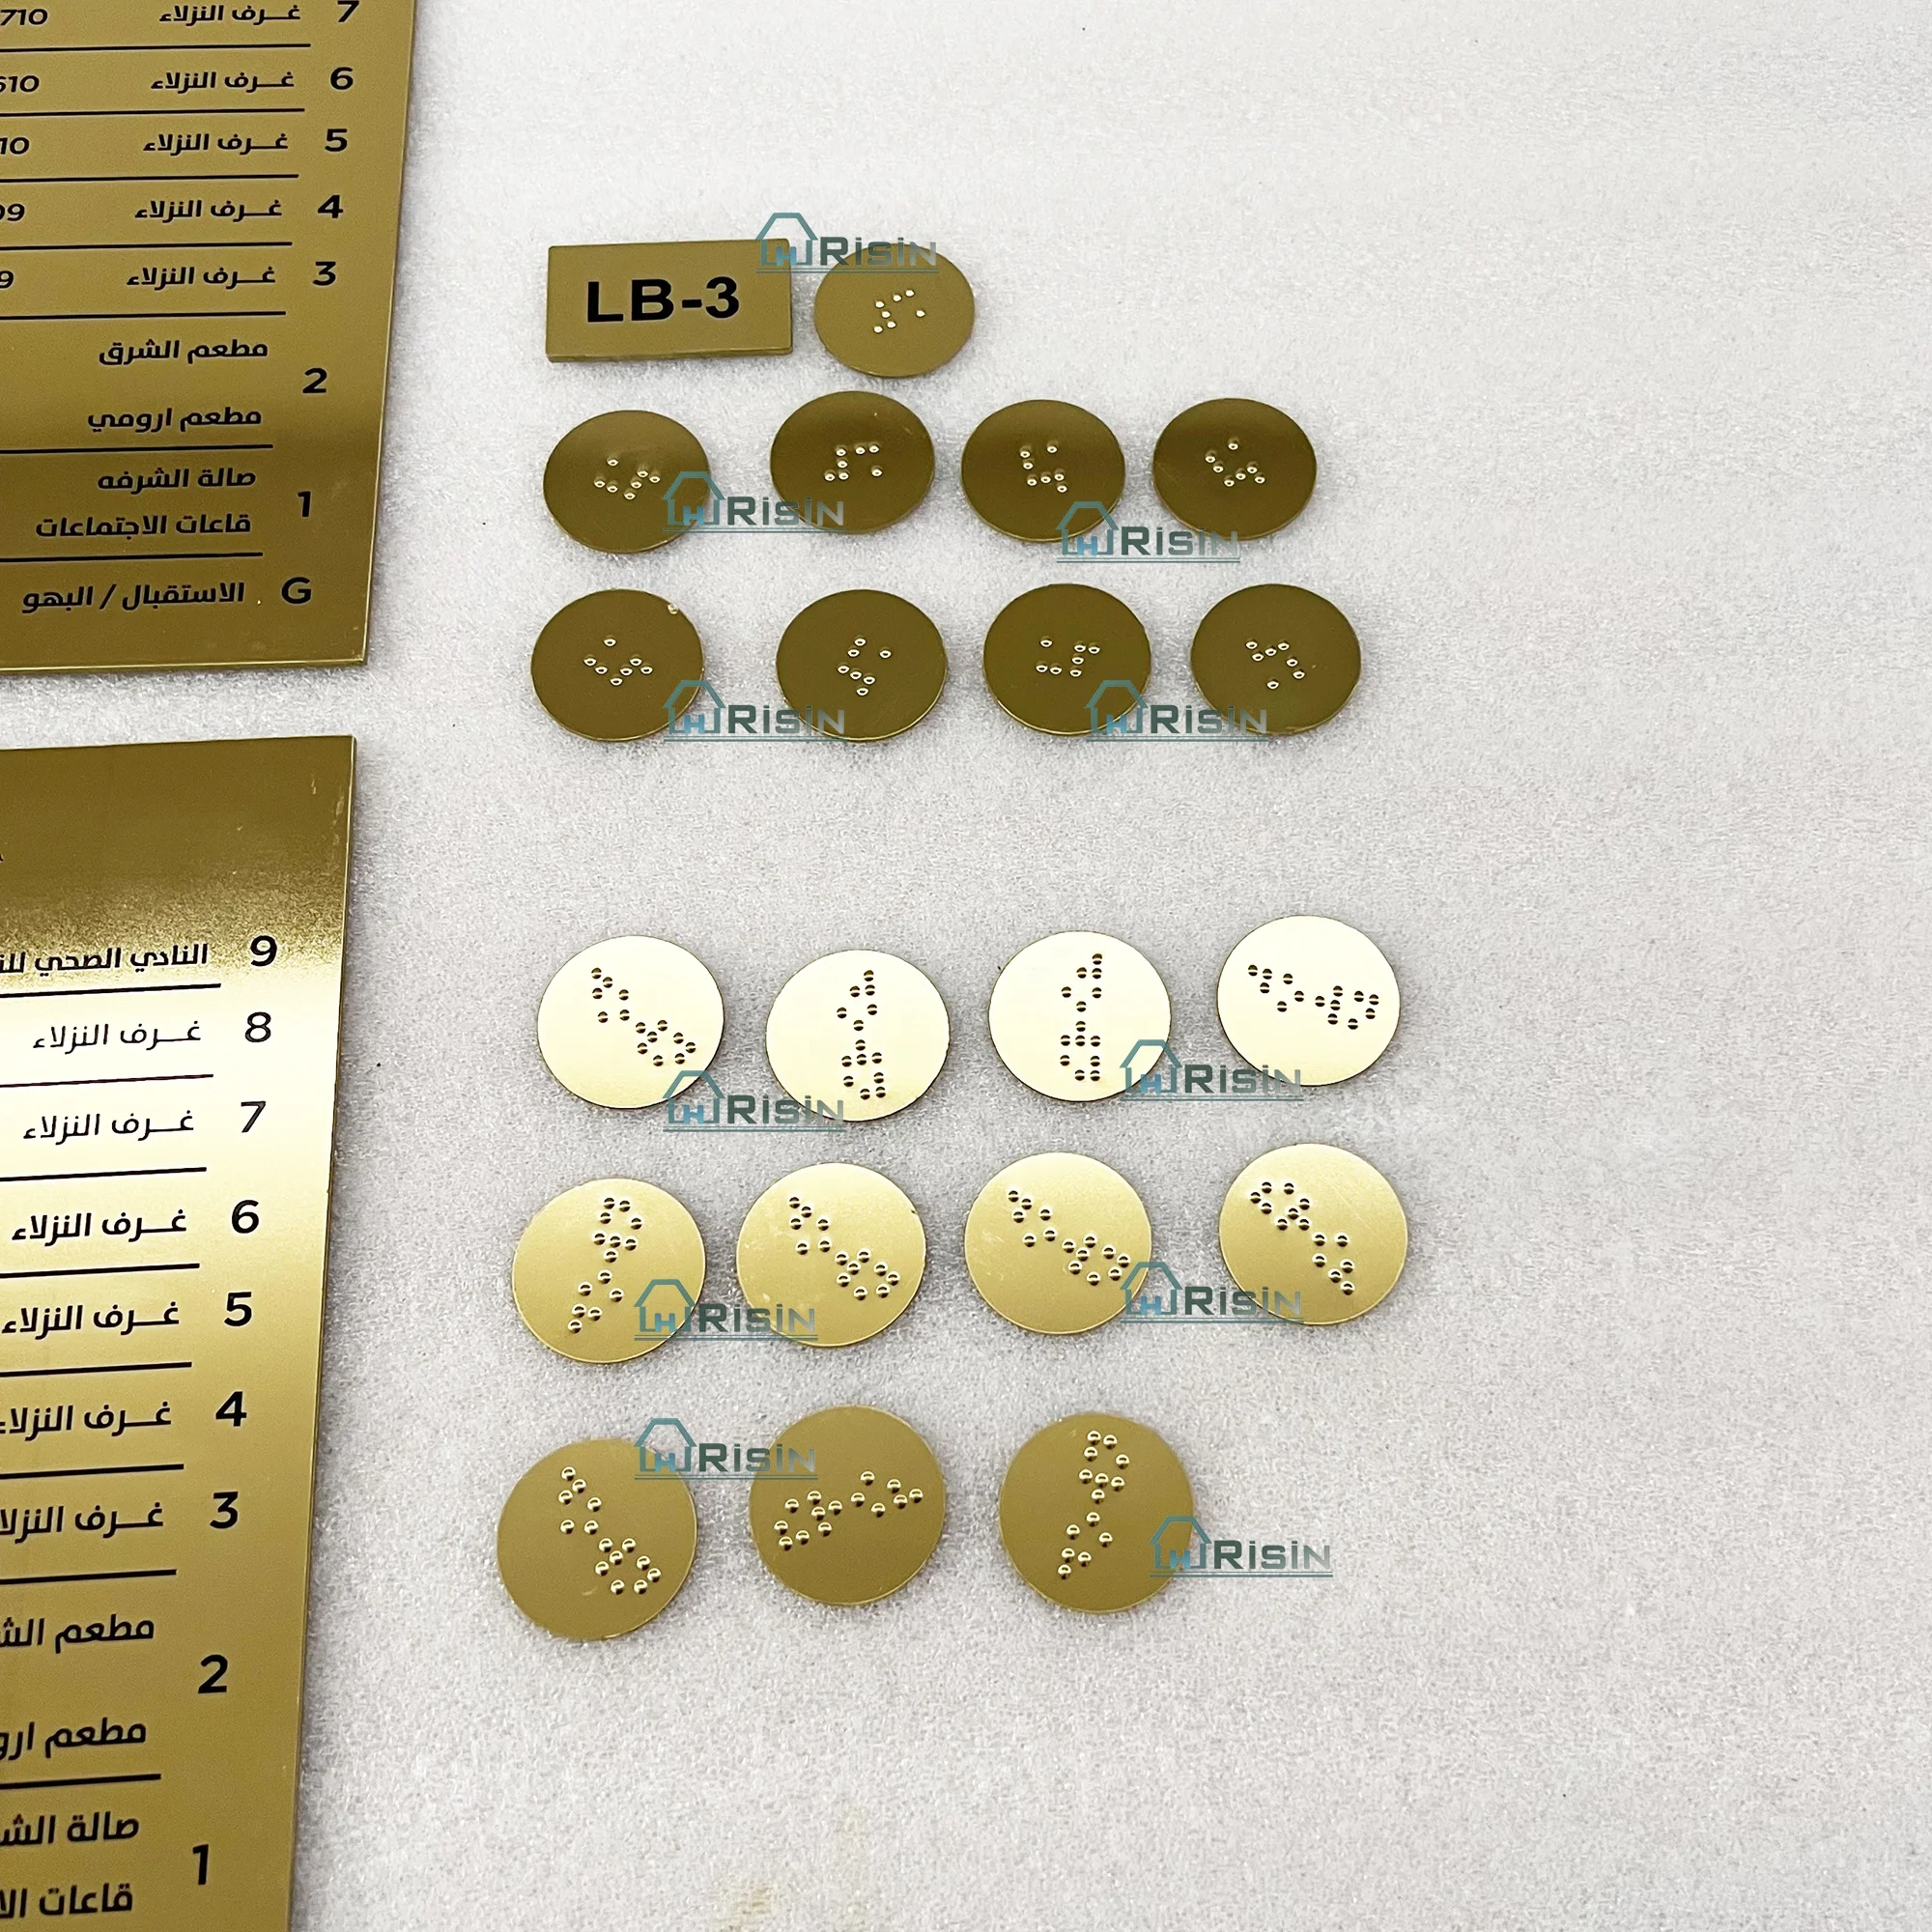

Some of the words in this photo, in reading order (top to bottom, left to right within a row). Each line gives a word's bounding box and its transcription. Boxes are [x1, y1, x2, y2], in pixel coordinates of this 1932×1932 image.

[159, 5, 224, 26] النزلاء
[338, 0, 359, 22] 7
[151, 71, 216, 94] النزلاء
[330, 67, 353, 90] 6
[143, 133, 210, 156] النزلاء
[325, 128, 347, 152] 5
[135, 201, 202, 223] النزلاء
[318, 195, 343, 218] 4
[127, 267, 194, 291] النزلاء
[313, 262, 336, 286] 3
[587, 276, 739, 323] LB-3
[99, 339, 180, 365] الشرق
[187, 339, 268, 364] مطعم
[302, 368, 327, 393] 2
[88, 408, 172, 433] ارومي
[181, 407, 261, 432] مطعم
[198, 468, 256, 487] صالة
[298, 492, 310, 517] 1
[36, 515, 167, 540] الاجتماعات
[176, 514, 250, 533] قاعات
[22, 586, 93, 613] البهو
[123, 582, 244, 611] الاستقبال
[282, 577, 311, 604] G
[35, 948, 121, 977] الصحي
[130, 943, 209, 973] النادي
[250, 935, 277, 966] 9
[33, 1024, 108, 1054] النزلاء
[245, 1012, 270, 1042] 8
[23, 1114, 99, 1145] النزلاء
[242, 1101, 266, 1132] 7
[12, 1213, 91, 1246] النزلاء
[232, 1200, 259, 1234] 6
[1, 1305, 83, 1340] النزلاء
[224, 1292, 251, 1326] 5
[215, 1391, 246, 1427] 4
[210, 1492, 238, 1528] 3
[55, 1614, 154, 1654] مطعم
[198, 1655, 228, 1693] 2
[45, 1718, 146, 1758] مطعم
[67, 1811, 139, 1842] صالة
[193, 1844, 209, 1886] 1
[40, 1883, 132, 1916] قاعات
